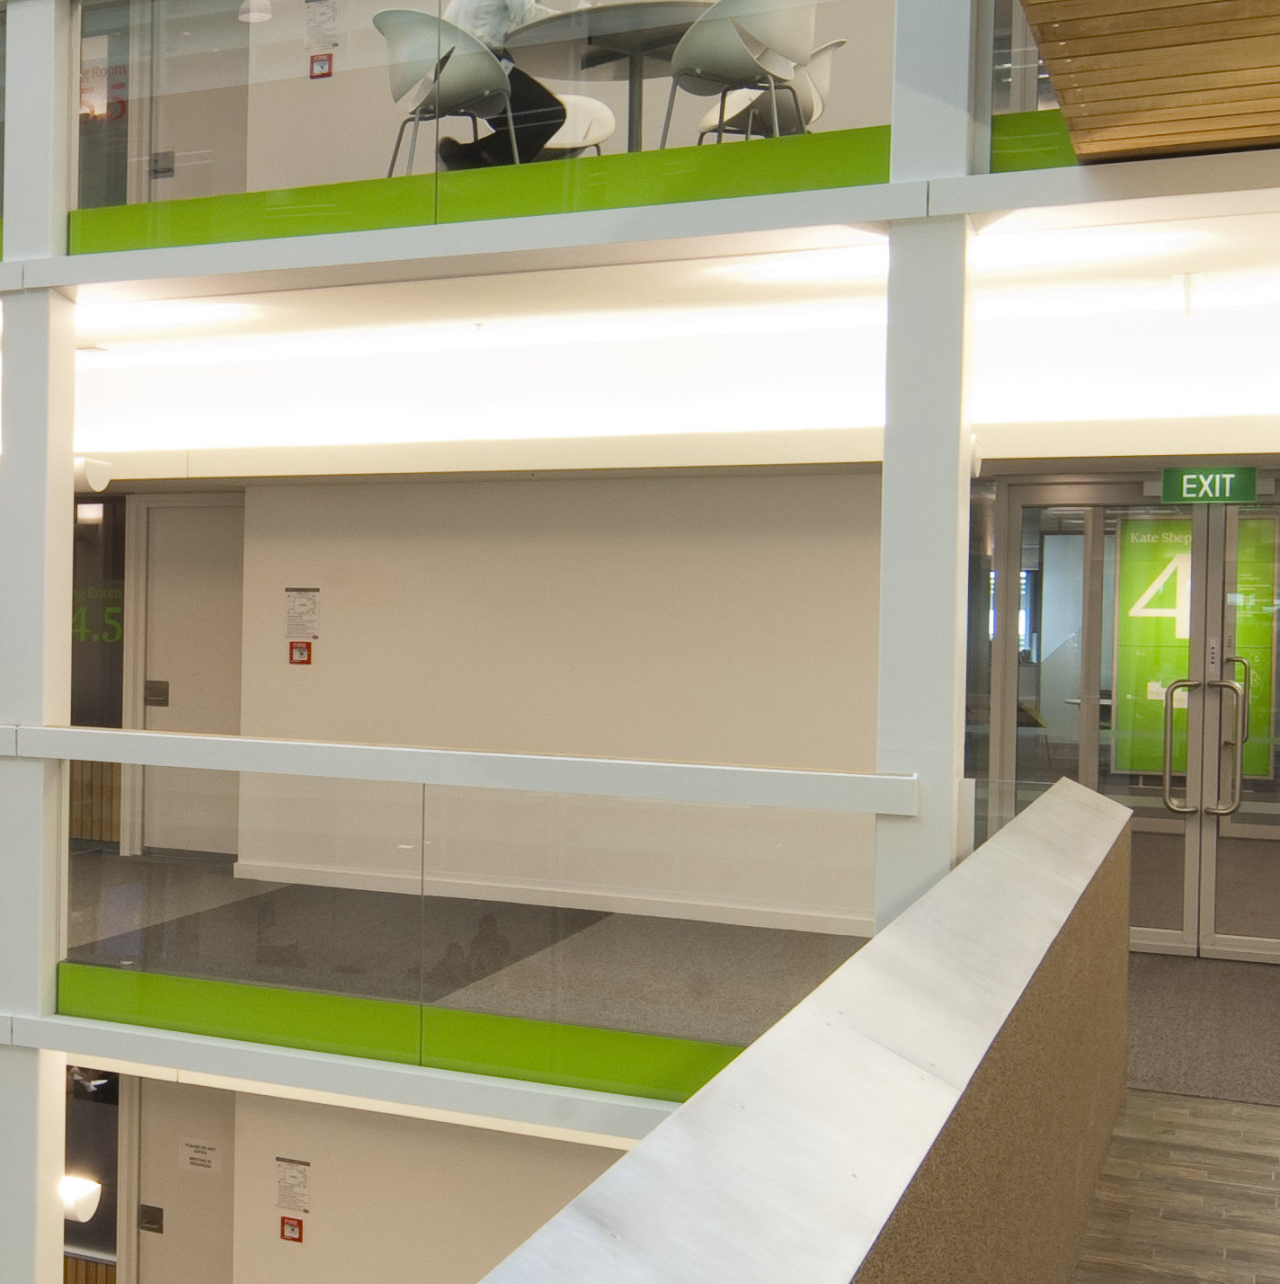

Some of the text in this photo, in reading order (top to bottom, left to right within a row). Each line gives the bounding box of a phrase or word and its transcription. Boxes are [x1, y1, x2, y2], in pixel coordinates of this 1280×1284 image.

[1182, 473, 1235, 498] EXIT
[1130, 532, 1159, 543] Kate
[1128, 553, 1192, 639] 4
[72, 606, 122, 642] 4.5
